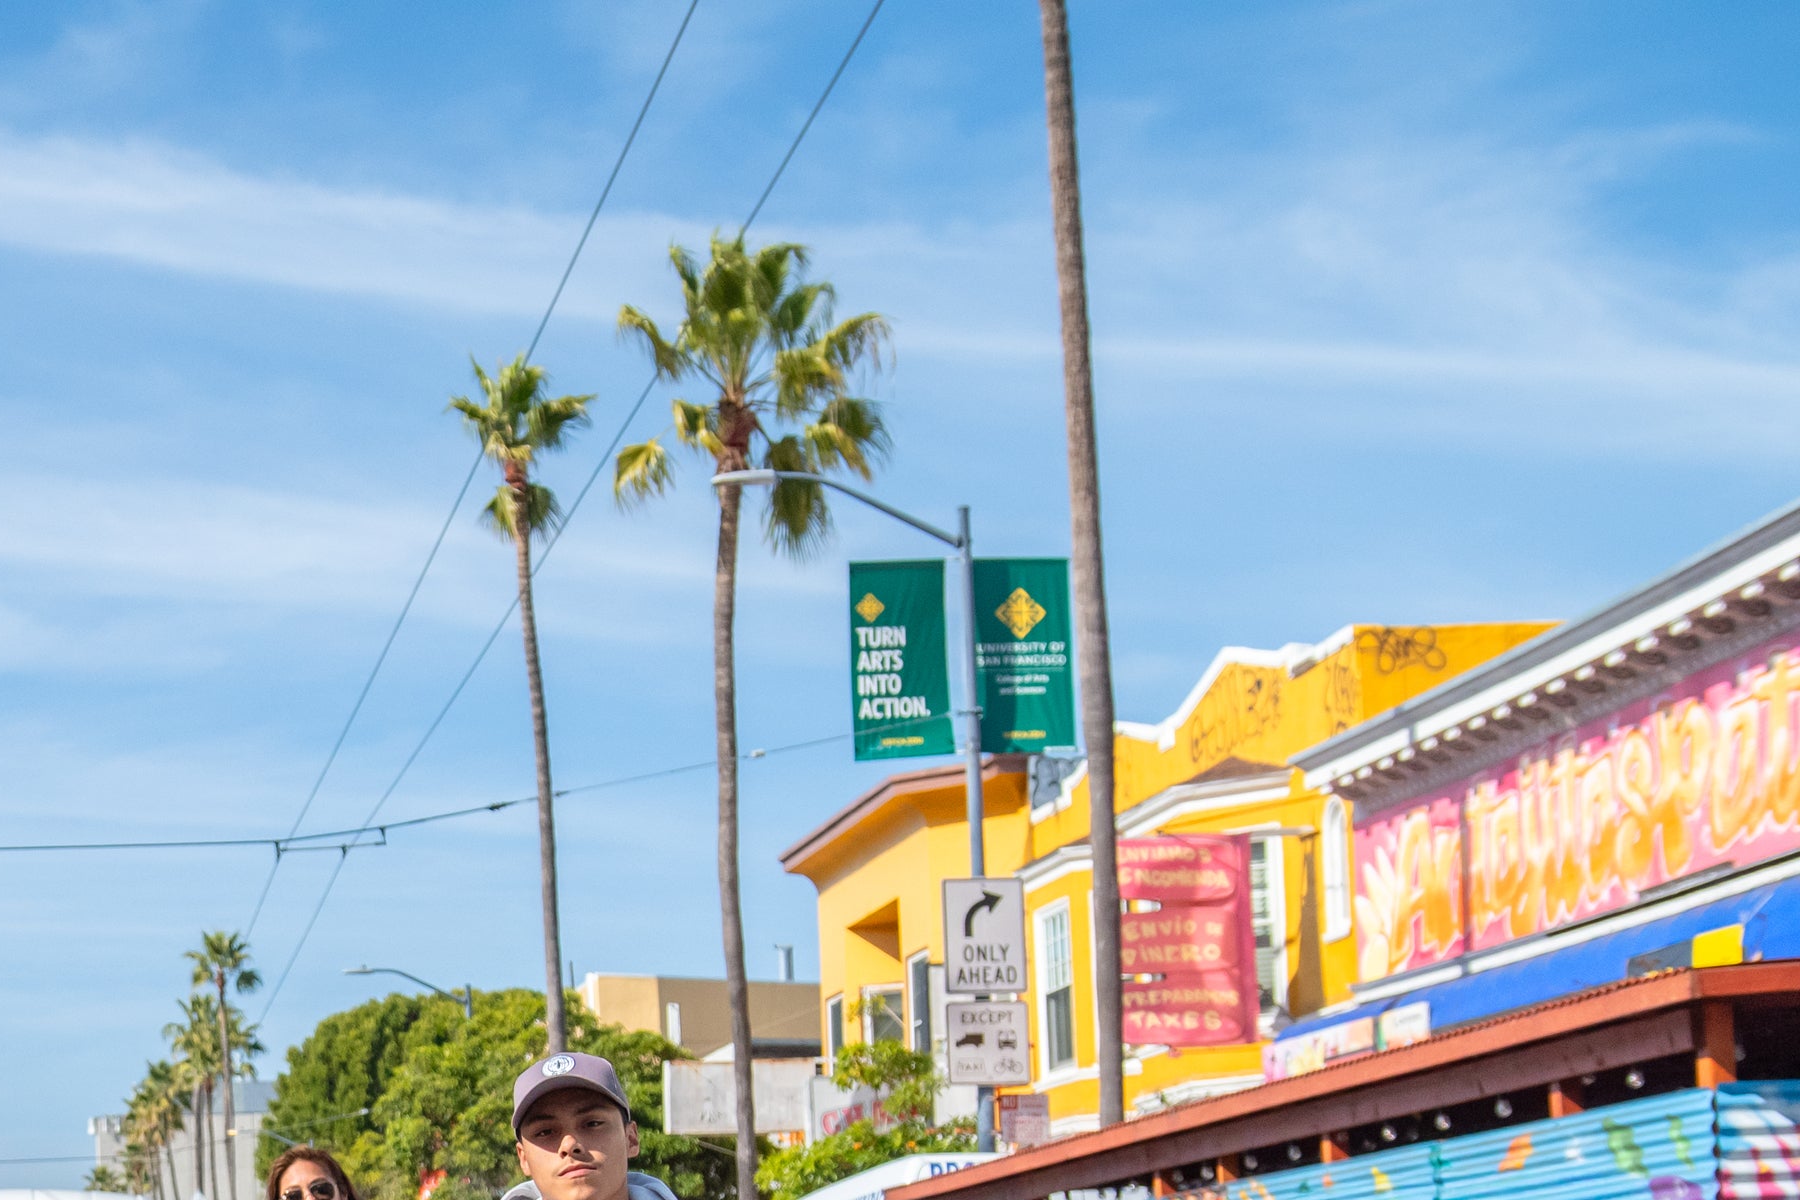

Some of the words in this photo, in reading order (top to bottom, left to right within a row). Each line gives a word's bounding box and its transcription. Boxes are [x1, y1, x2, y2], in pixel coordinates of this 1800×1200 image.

[855, 626, 907, 648] TURN
[976, 641, 1047, 653] UNIVERSITY
[1050, 641, 1066, 653] OF
[856, 650, 904, 672] ARTS
[976, 655, 1000, 667] SAN
[1003, 655, 1067, 667] FRANCISCO
[857, 674, 902, 696] INTO
[858, 696, 931, 720] ACTION.
[963, 944, 1010, 962] ONLY
[957, 966, 1018, 985] AHEAD
[960, 1010, 1014, 1025] EXCEPT
[1129, 1010, 1223, 1030] TAXES
[960, 1062, 984, 1072] TAXI
